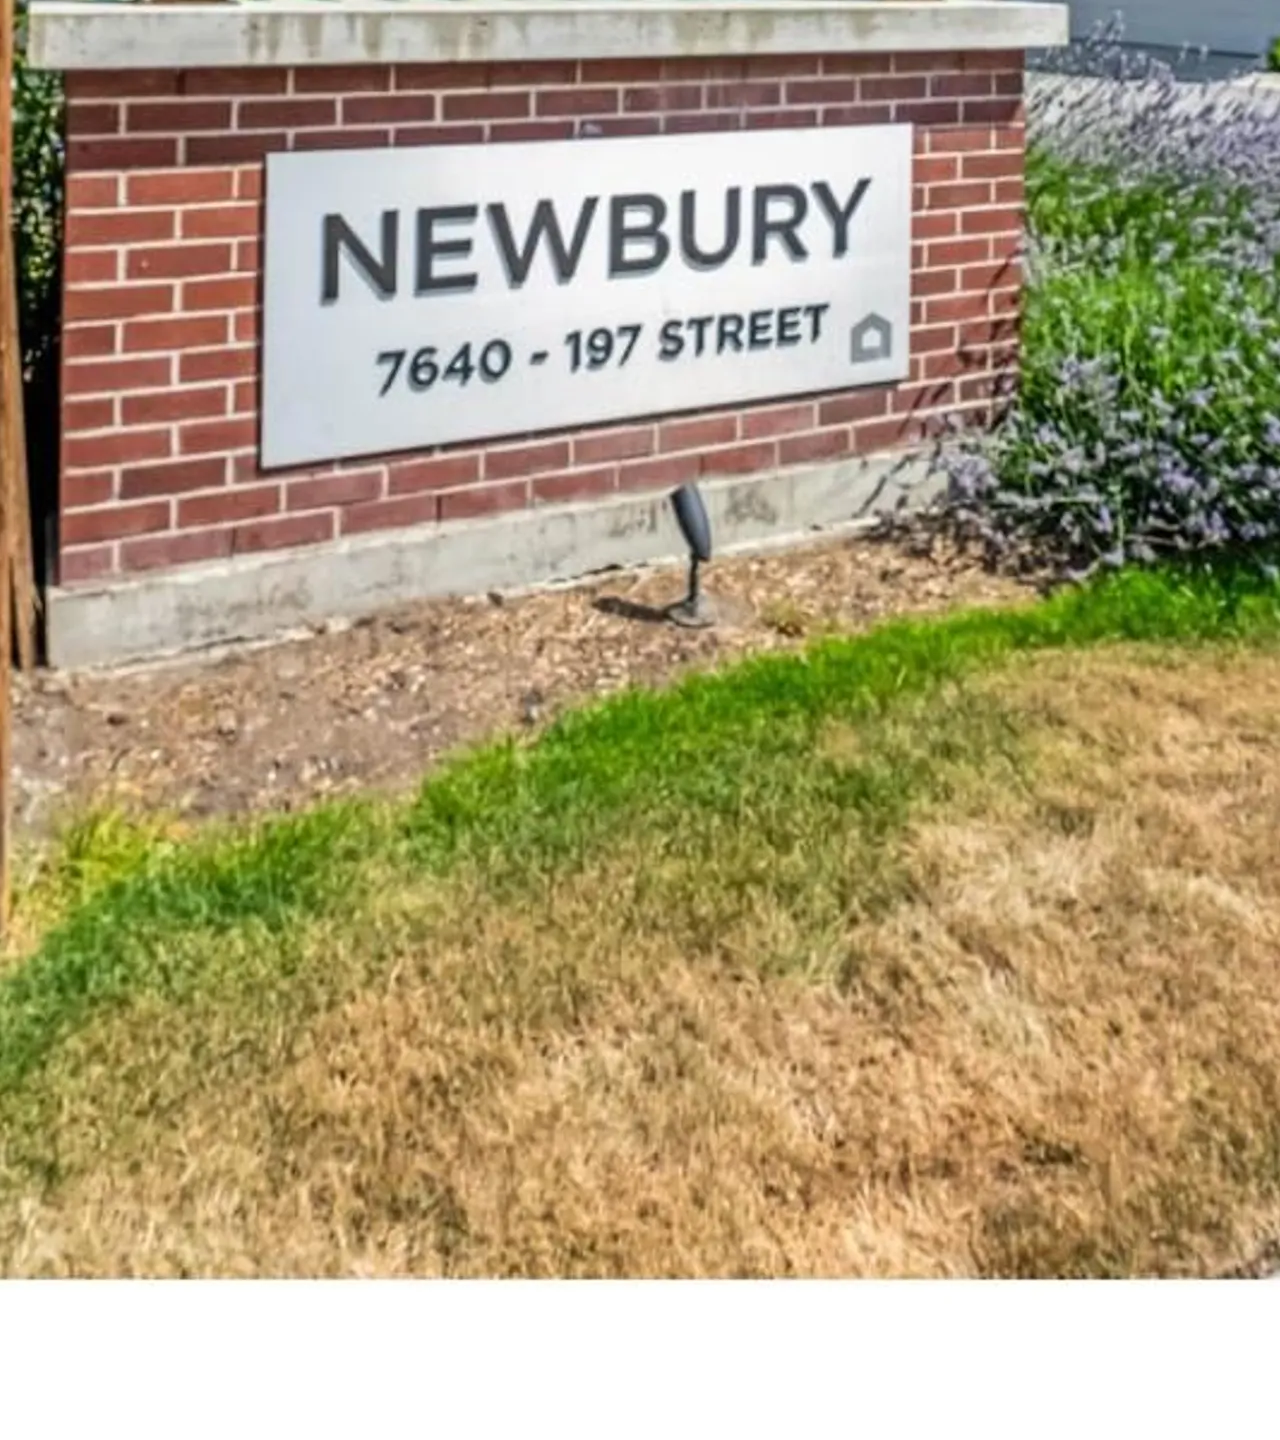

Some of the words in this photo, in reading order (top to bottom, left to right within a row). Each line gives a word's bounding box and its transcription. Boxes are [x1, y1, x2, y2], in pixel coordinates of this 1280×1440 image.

[320, 178, 871, 305] NEWBURY
[376, 339, 512, 396] 7640
[564, 324, 642, 374] 197
[658, 303, 830, 360] STREET
